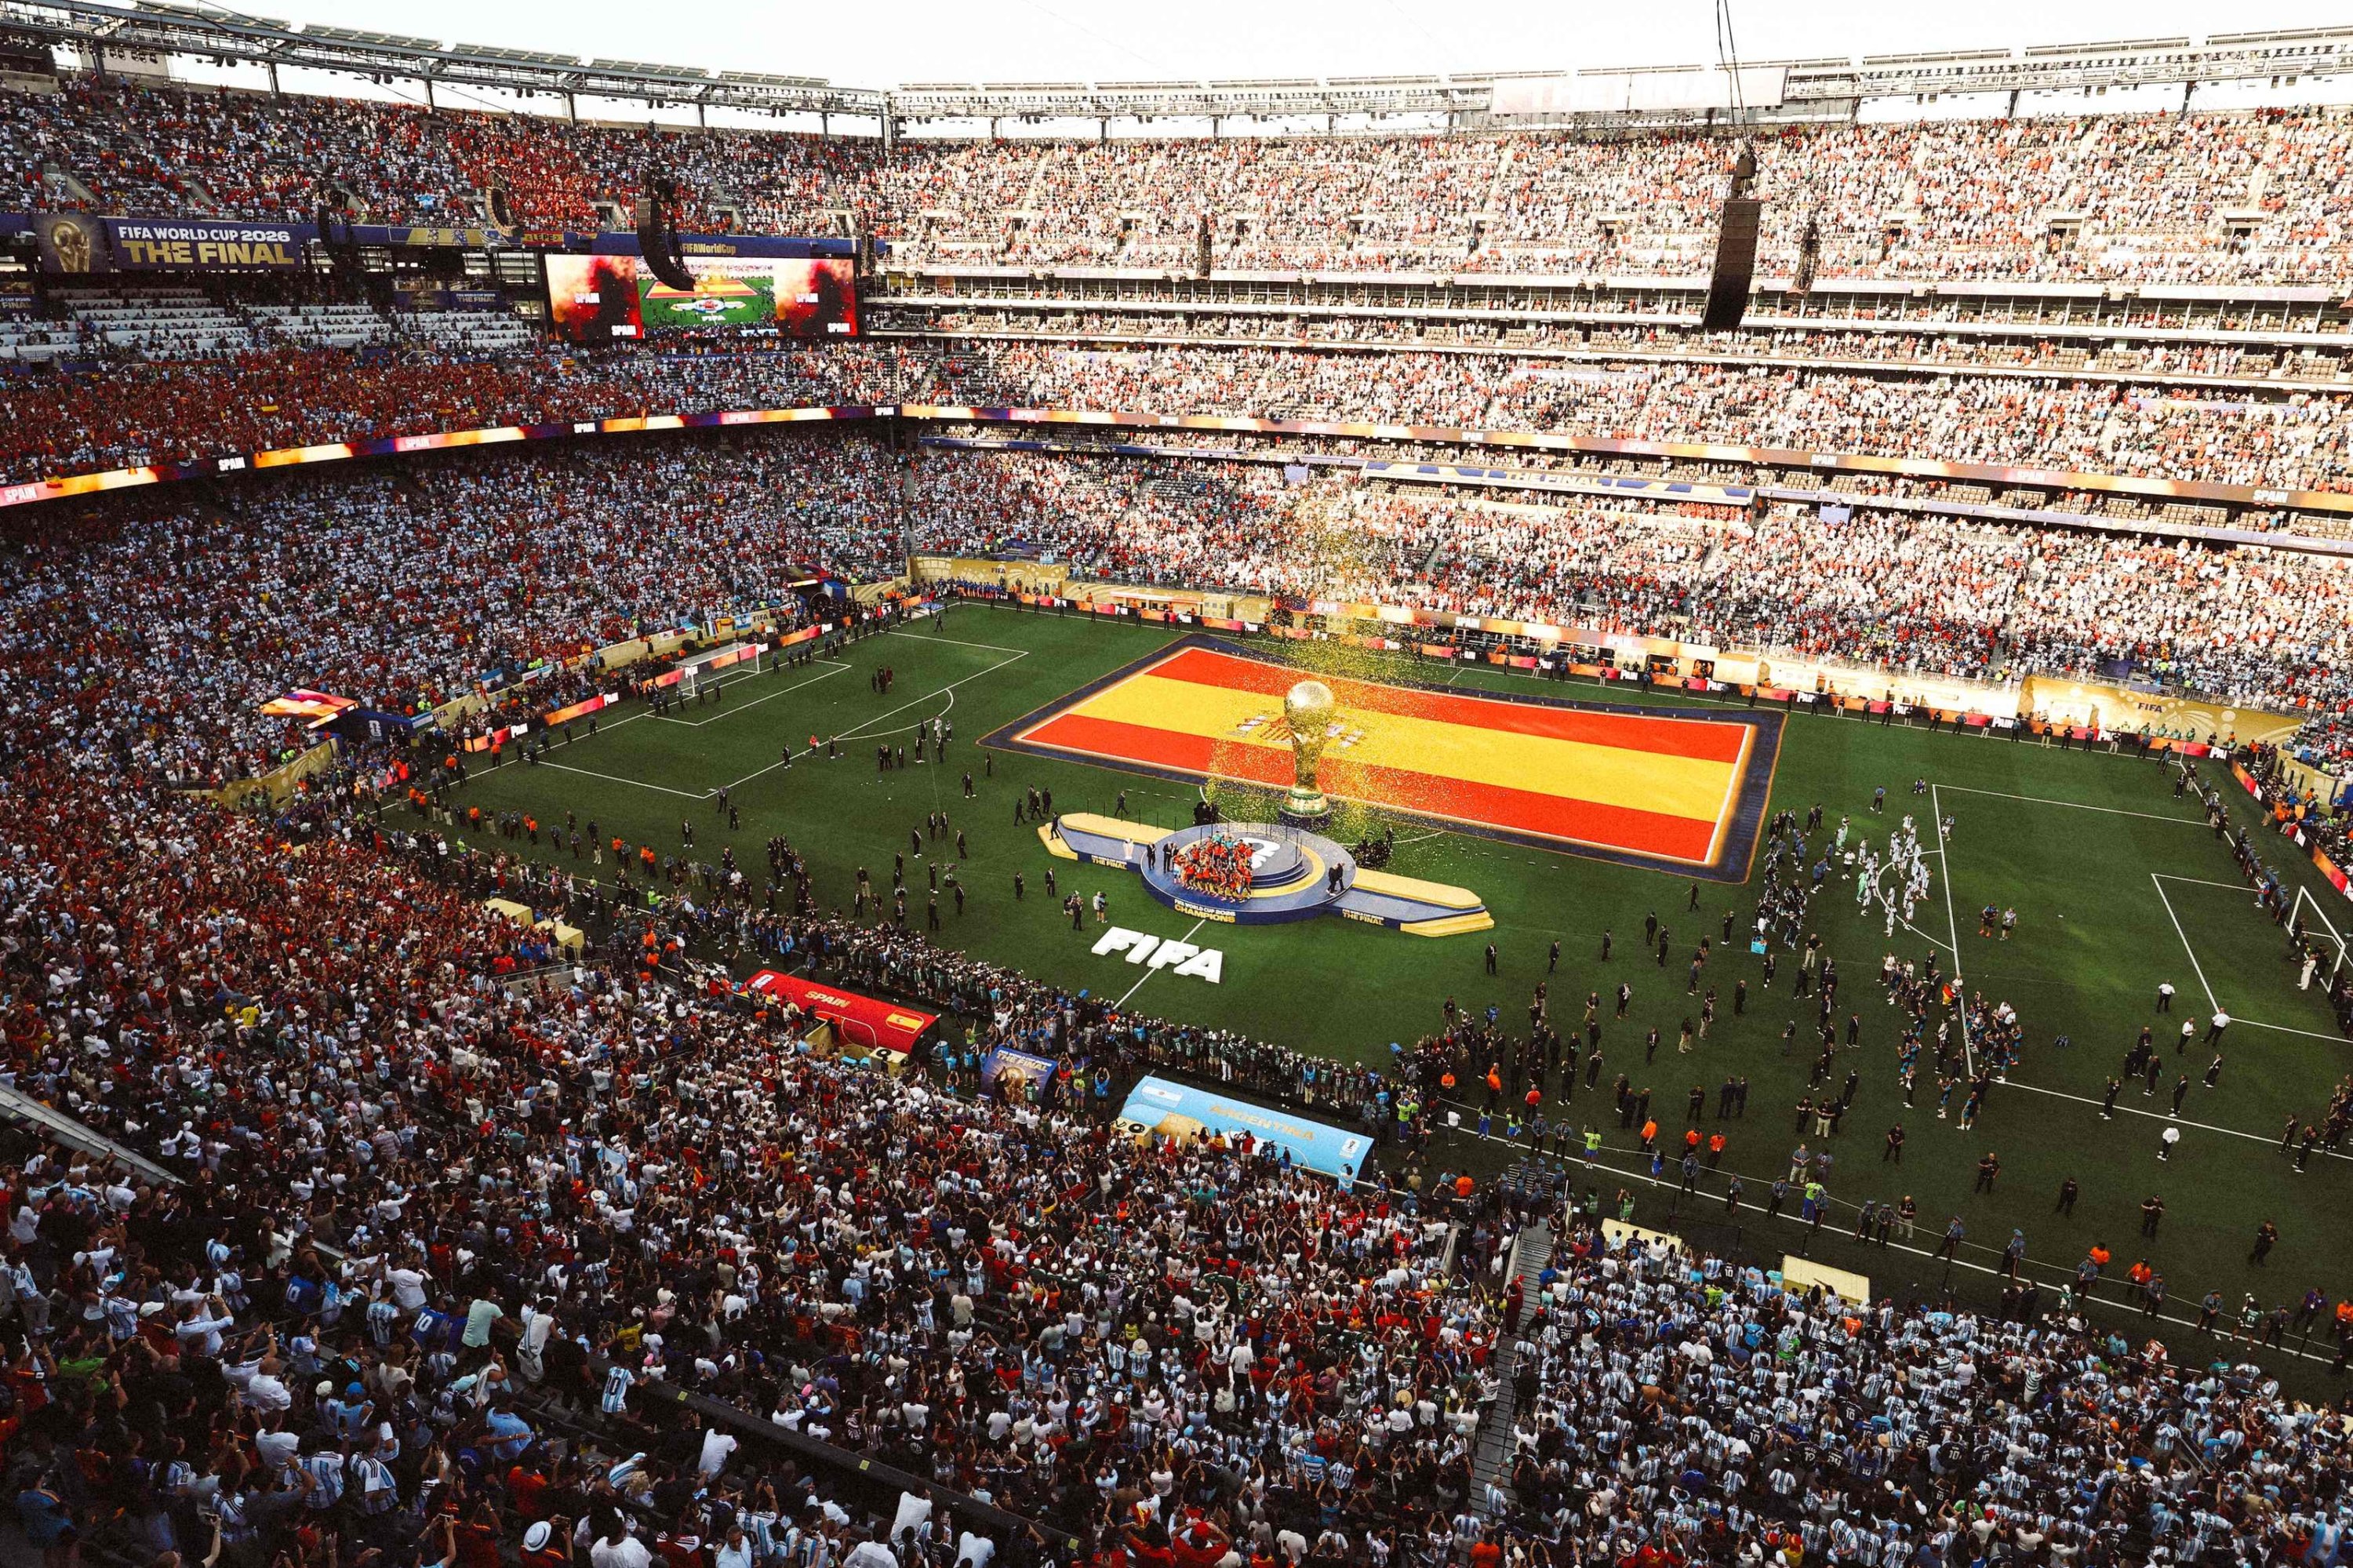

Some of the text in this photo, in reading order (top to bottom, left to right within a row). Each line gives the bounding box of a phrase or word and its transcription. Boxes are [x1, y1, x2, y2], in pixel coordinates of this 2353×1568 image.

[118, 226, 291, 242] FIFA WORLD CUP 2026
[121, 240, 295, 264] THE FINAL
[680, 243, 736, 255] FIFAWorldCup
[574, 293, 600, 304] SPAIN
[795, 293, 819, 304] SPAIN
[611, 325, 637, 337] SPAIN
[827, 322, 850, 333] SPAIN
[573, 422, 596, 434] SPAIN
[406, 437, 431, 449] SPAIN
[218, 456, 245, 471] SPAIN
[1810, 453, 1838, 466] SPAIN
[4, 486, 38, 503] SPAIN
[2252, 489, 2289, 504] SPAIN
[753, 614, 769, 623] FIFA
[2138, 702, 2163, 713] FIFA
[432, 709, 449, 722] FIFA
[1185, 903, 1203, 911] WORLD
[1174, 904, 1235, 923] CHAMPIONS
[1343, 912, 1384, 926] THE FINAL
[1091, 926, 1224, 984] FIFA
[805, 991, 851, 1008] SPAIN
[996, 1053, 1048, 1072] THE FINAL
[1209, 1105, 1315, 1141] ARGENTINA
[286, 1283, 300, 1302] 10
[1381, 1284, 1391, 1293] 10
[414, 1312, 433, 1333] 10
[1814, 1344, 1827, 1352] 32
[1913, 1373, 1922, 1382] 19
[607, 1376, 621, 1395] 10
[1708, 1406, 1715, 1414] 7
[1846, 1410, 1855, 1421] 10
[1709, 1438, 1719, 1449] 10
[1750, 1432, 1760, 1444] 10
[1915, 1438, 1929, 1448] 26
[1805, 1451, 1815, 1461] 19
[1949, 1450, 1959, 1460] 10
[1337, 1468, 1349, 1482] 10
[2012, 1480, 2023, 1490] 10
[2201, 1521, 2213, 1533] 10
[1862, 1539, 1872, 1552] 10
[1895, 1550, 1907, 1561] 10
